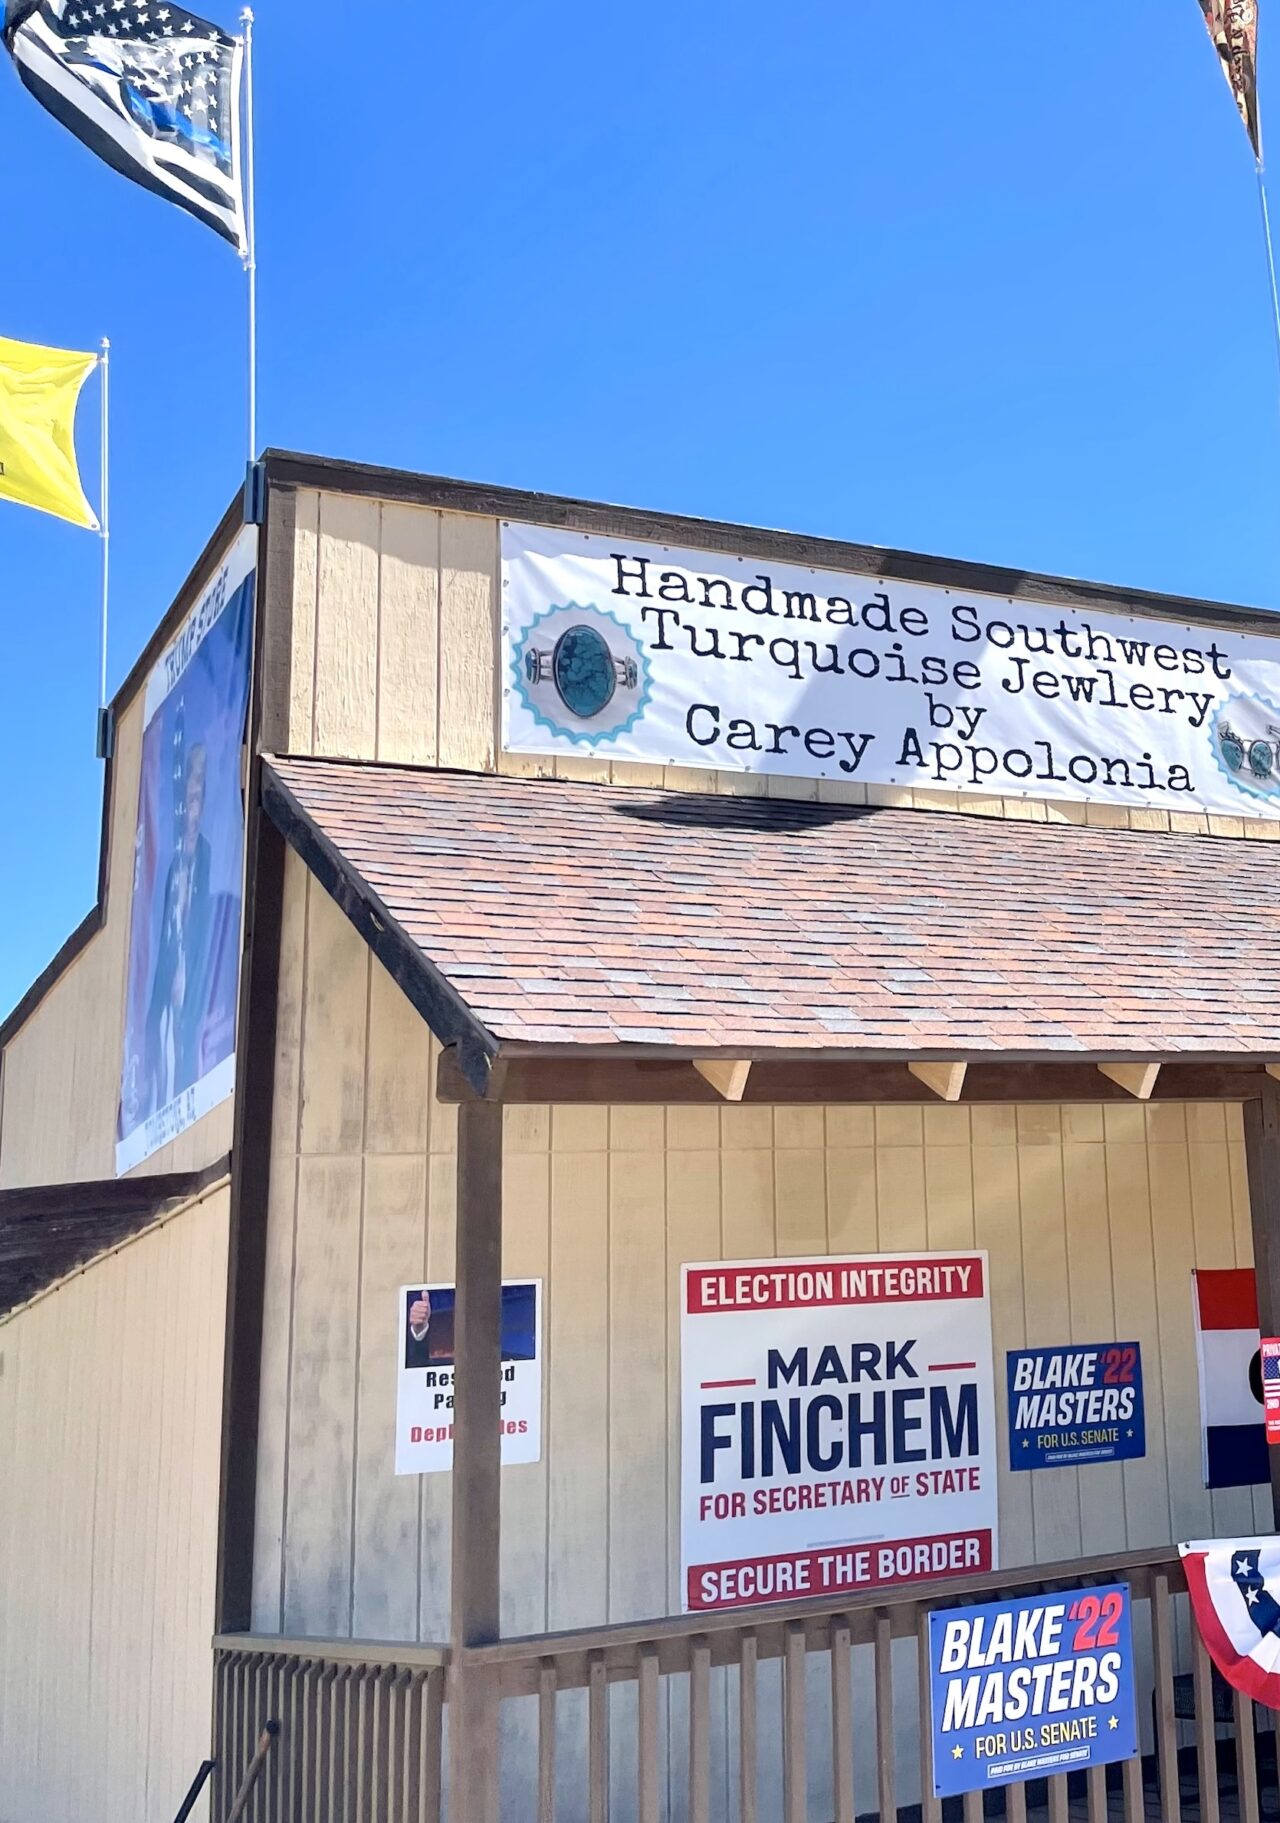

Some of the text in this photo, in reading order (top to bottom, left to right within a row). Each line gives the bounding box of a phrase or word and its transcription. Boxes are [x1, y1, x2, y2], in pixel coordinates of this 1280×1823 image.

[609, 553, 1232, 680] Handmade Southwest
[165, 617, 197, 693] TRUMP
[640, 607, 1214, 728] Turquoise Jewlery
[925, 692, 986, 740] by
[684, 702, 1196, 793] Carey Appolonia
[701, 1265, 973, 1306] ELECTION INTEGRITY
[767, 1340, 919, 1389] MARK
[1013, 1353, 1098, 1392] BLAKE
[700, 1383, 980, 1484] FINCHEM
[1015, 1387, 1135, 1430] MASTERS
[1037, 1428, 1119, 1449] FOR U.S. SENATE
[700, 1466, 981, 1521] FOR SECRETARY OF STATE
[700, 1538, 981, 1603] SECURE THE BORDER
[940, 1604, 1065, 1674] BLAKE
[941, 1652, 1122, 1732] MASTERS
[975, 1716, 1097, 1759] FOR U.S. SENATE
